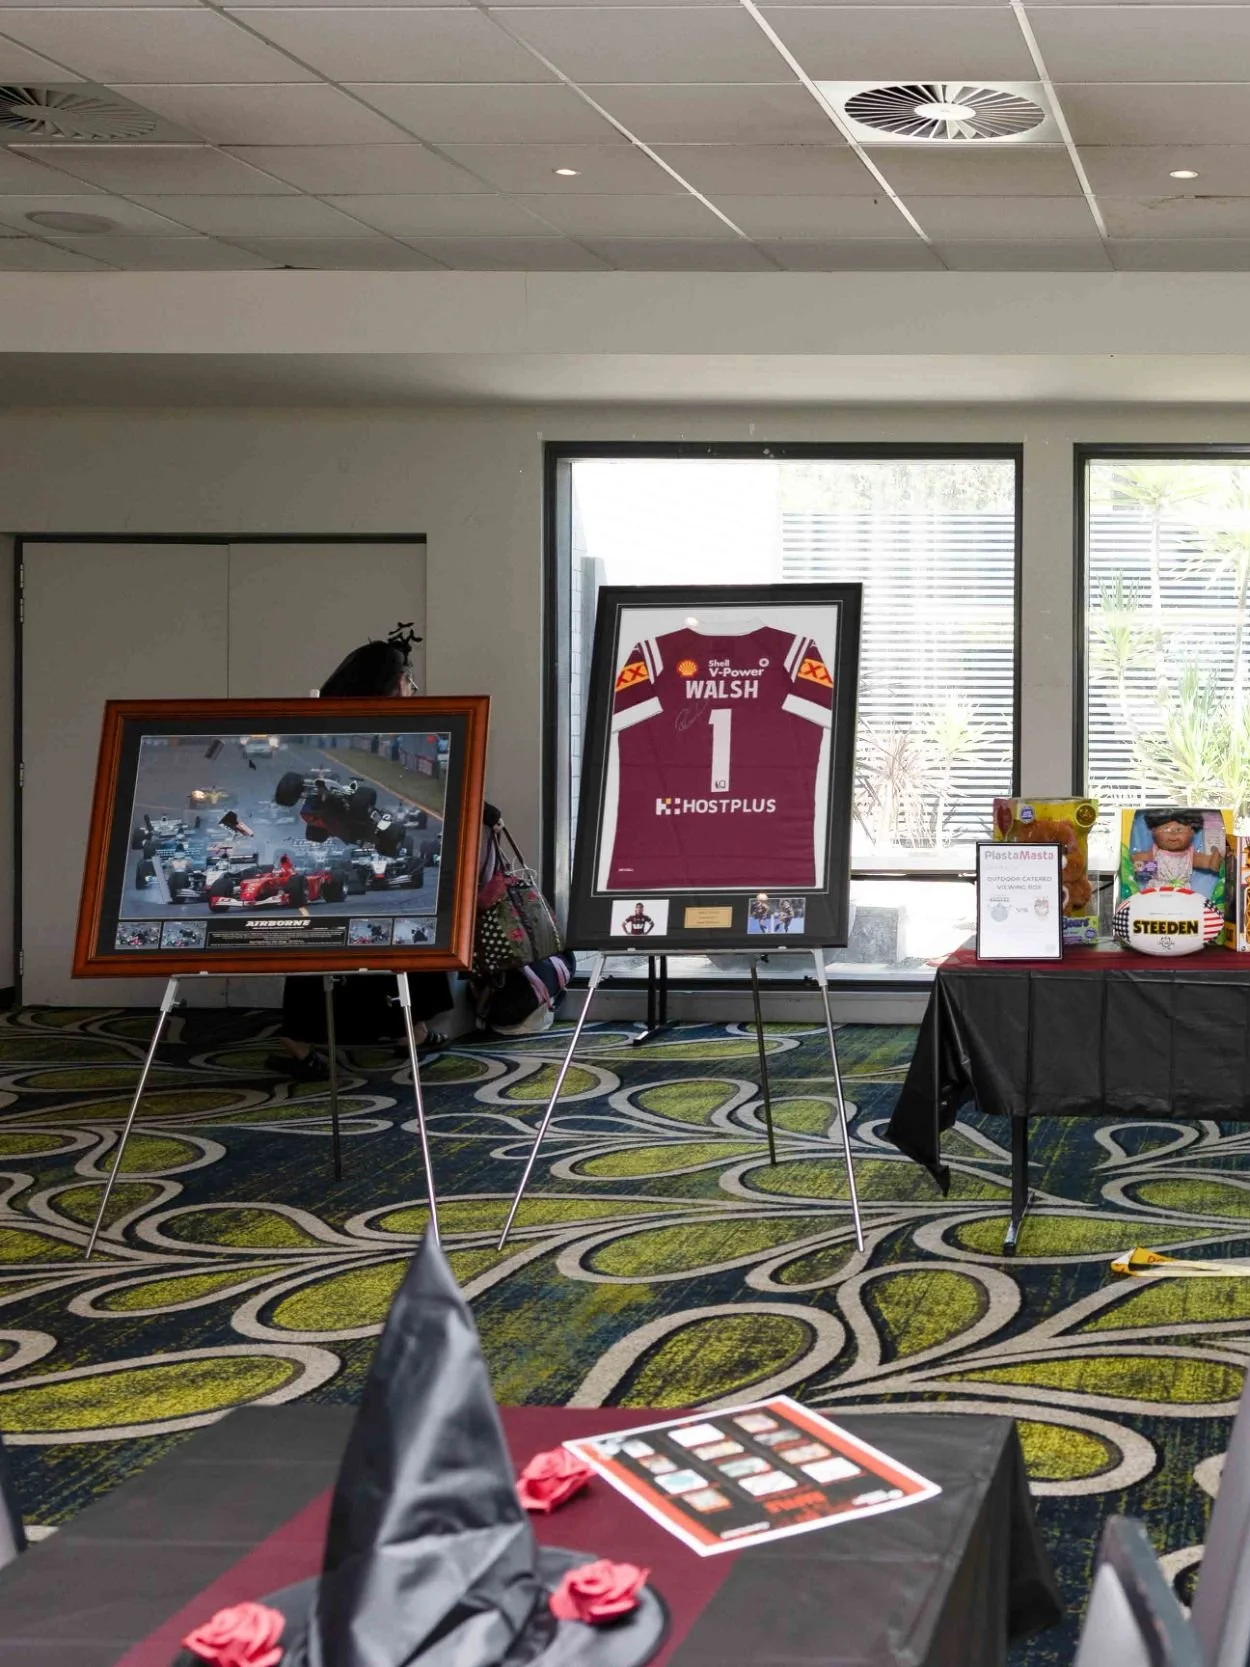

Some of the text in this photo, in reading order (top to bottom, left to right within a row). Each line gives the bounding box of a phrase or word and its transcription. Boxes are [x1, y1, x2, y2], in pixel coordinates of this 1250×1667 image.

[709, 659, 729, 667] Shell
[709, 668, 764, 677] V-Power
[686, 680, 759, 698] WALSH
[708, 709, 732, 792] 1
[682, 799, 776, 813] HOSTPLUS
[984, 851, 1054, 860] PlastaMasta
[246, 919, 311, 927] AIRBORNE
[1133, 920, 1199, 935] STEEDEN
